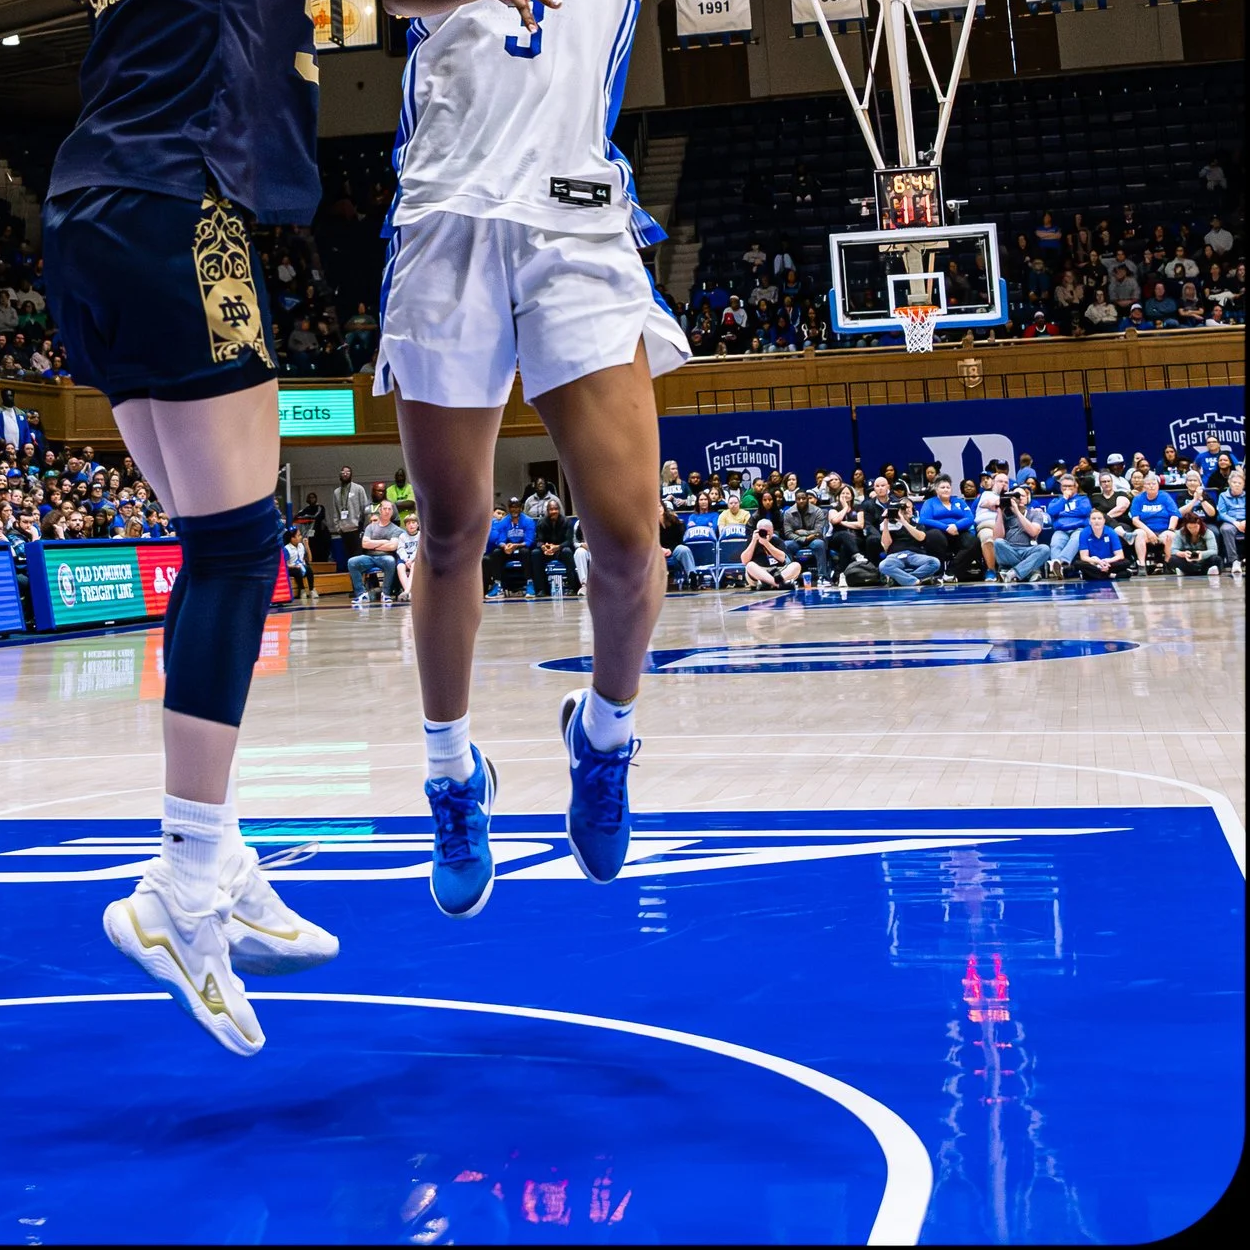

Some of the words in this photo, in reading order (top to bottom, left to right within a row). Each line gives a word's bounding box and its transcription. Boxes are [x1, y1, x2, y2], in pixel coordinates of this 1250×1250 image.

[698, 0, 730, 15] 1991
[893, 174, 934, 193] 6:44
[962, 364, 979, 382] 18
[293, 404, 331, 420] Eats
[713, 452, 777, 470] SISTERHOOD
[662, 485, 683, 495] DUKE
[689, 528, 710, 538] DUKE
[75, 567, 92, 582] OLD
[94, 564, 132, 581] DOMINION
[80, 584, 115, 602] FREIGHT
[117, 583, 134, 599] LINE
